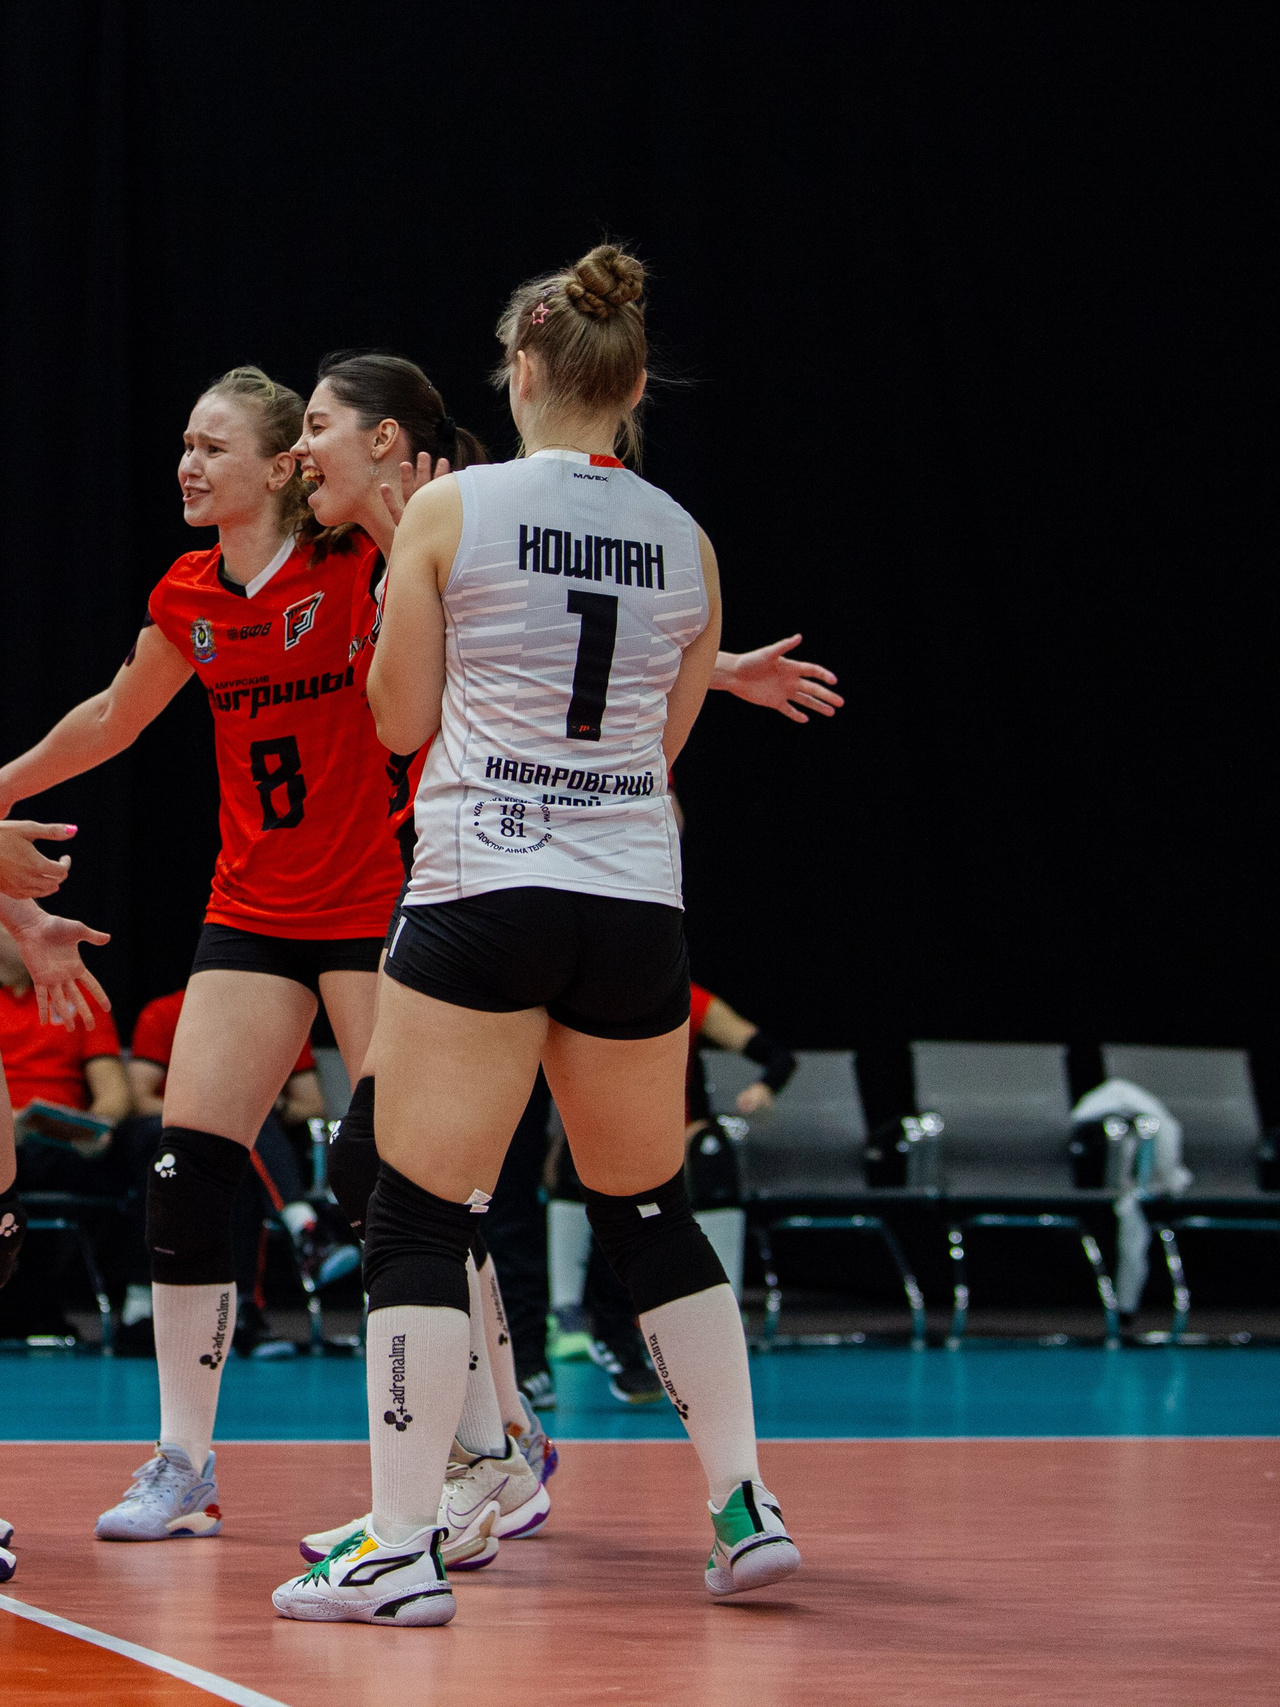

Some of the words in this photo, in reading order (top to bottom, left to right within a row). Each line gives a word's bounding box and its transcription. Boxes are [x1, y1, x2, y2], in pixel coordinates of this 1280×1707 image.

[519, 524, 665, 590] КОШМАН
[567, 589, 618, 742] 1
[250, 735, 307, 831] 8
[500, 803, 526, 820] 18
[500, 817, 527, 838] 81
